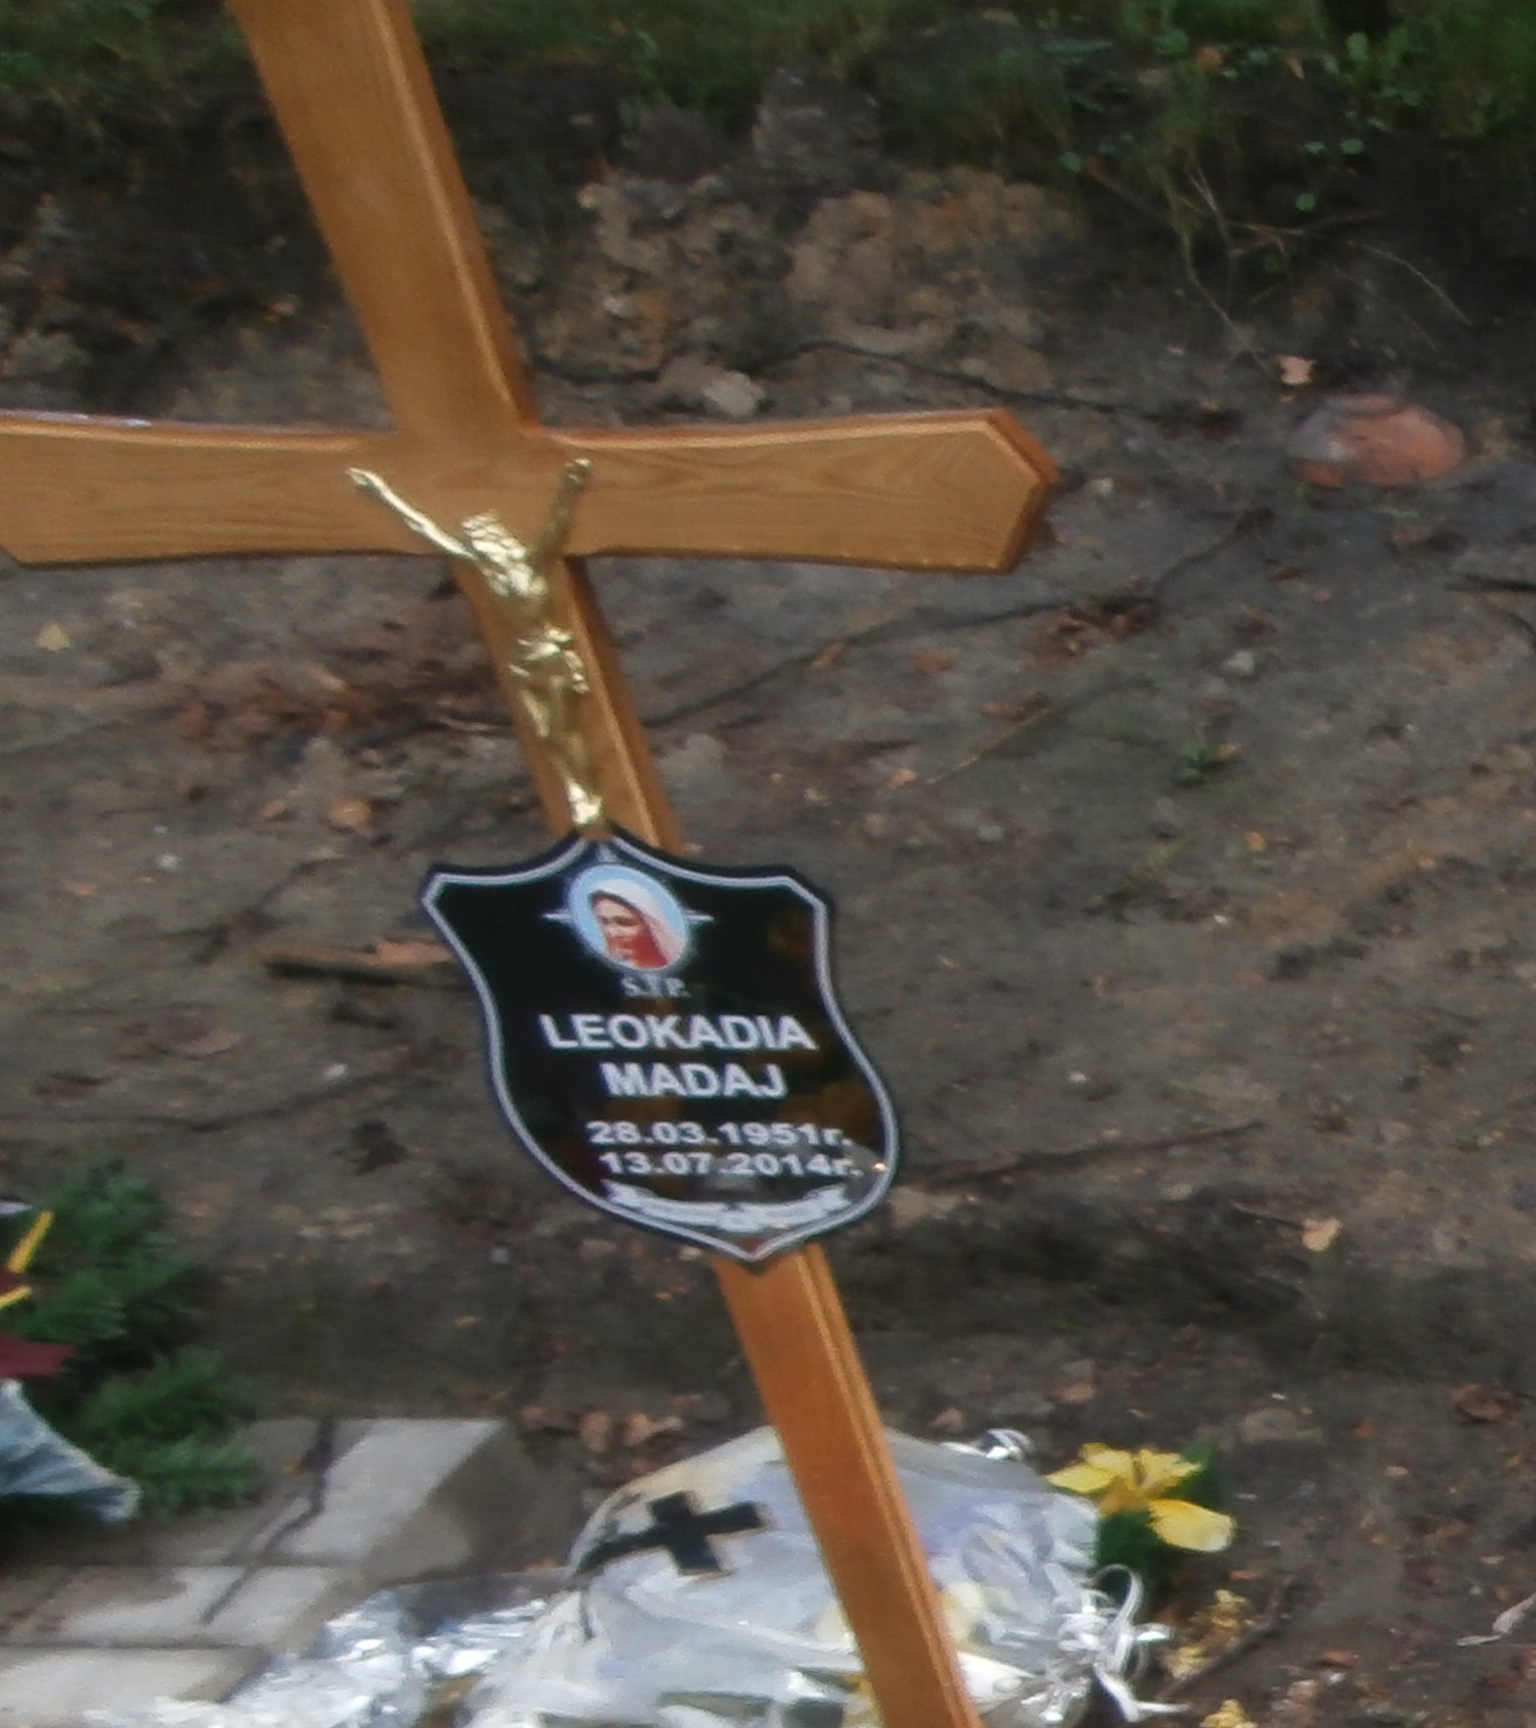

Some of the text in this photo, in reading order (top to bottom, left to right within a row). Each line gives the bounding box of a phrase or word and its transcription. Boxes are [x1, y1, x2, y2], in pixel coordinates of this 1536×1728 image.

[539, 1013, 819, 1051] LEOKADIA
[601, 1062, 790, 1098] MADAJ
[586, 1121, 853, 1147] 28.03.1951r.
[600, 1153, 864, 1178] 13.07.2014r.
